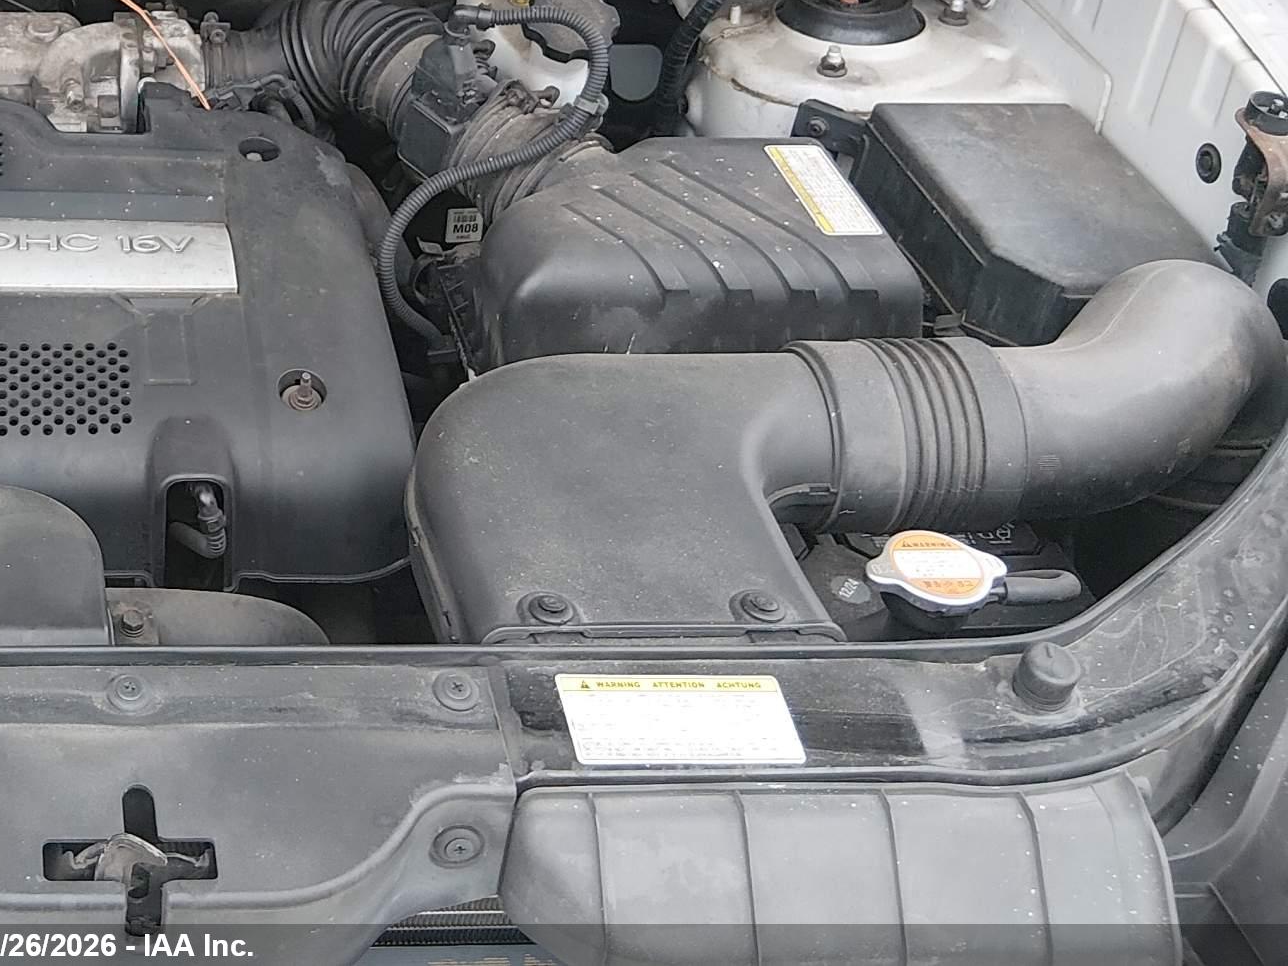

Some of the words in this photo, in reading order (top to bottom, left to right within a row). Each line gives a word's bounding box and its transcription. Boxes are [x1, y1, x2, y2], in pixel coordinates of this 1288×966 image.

[453, 223, 478, 234] M08
[117, 234, 194, 253] 16V
[839, 578, 859, 598] 12/24
[596, 681, 641, 689] WARNING
[652, 681, 705, 689] ATTENTION
[716, 681, 762, 689] ACHTUNG
